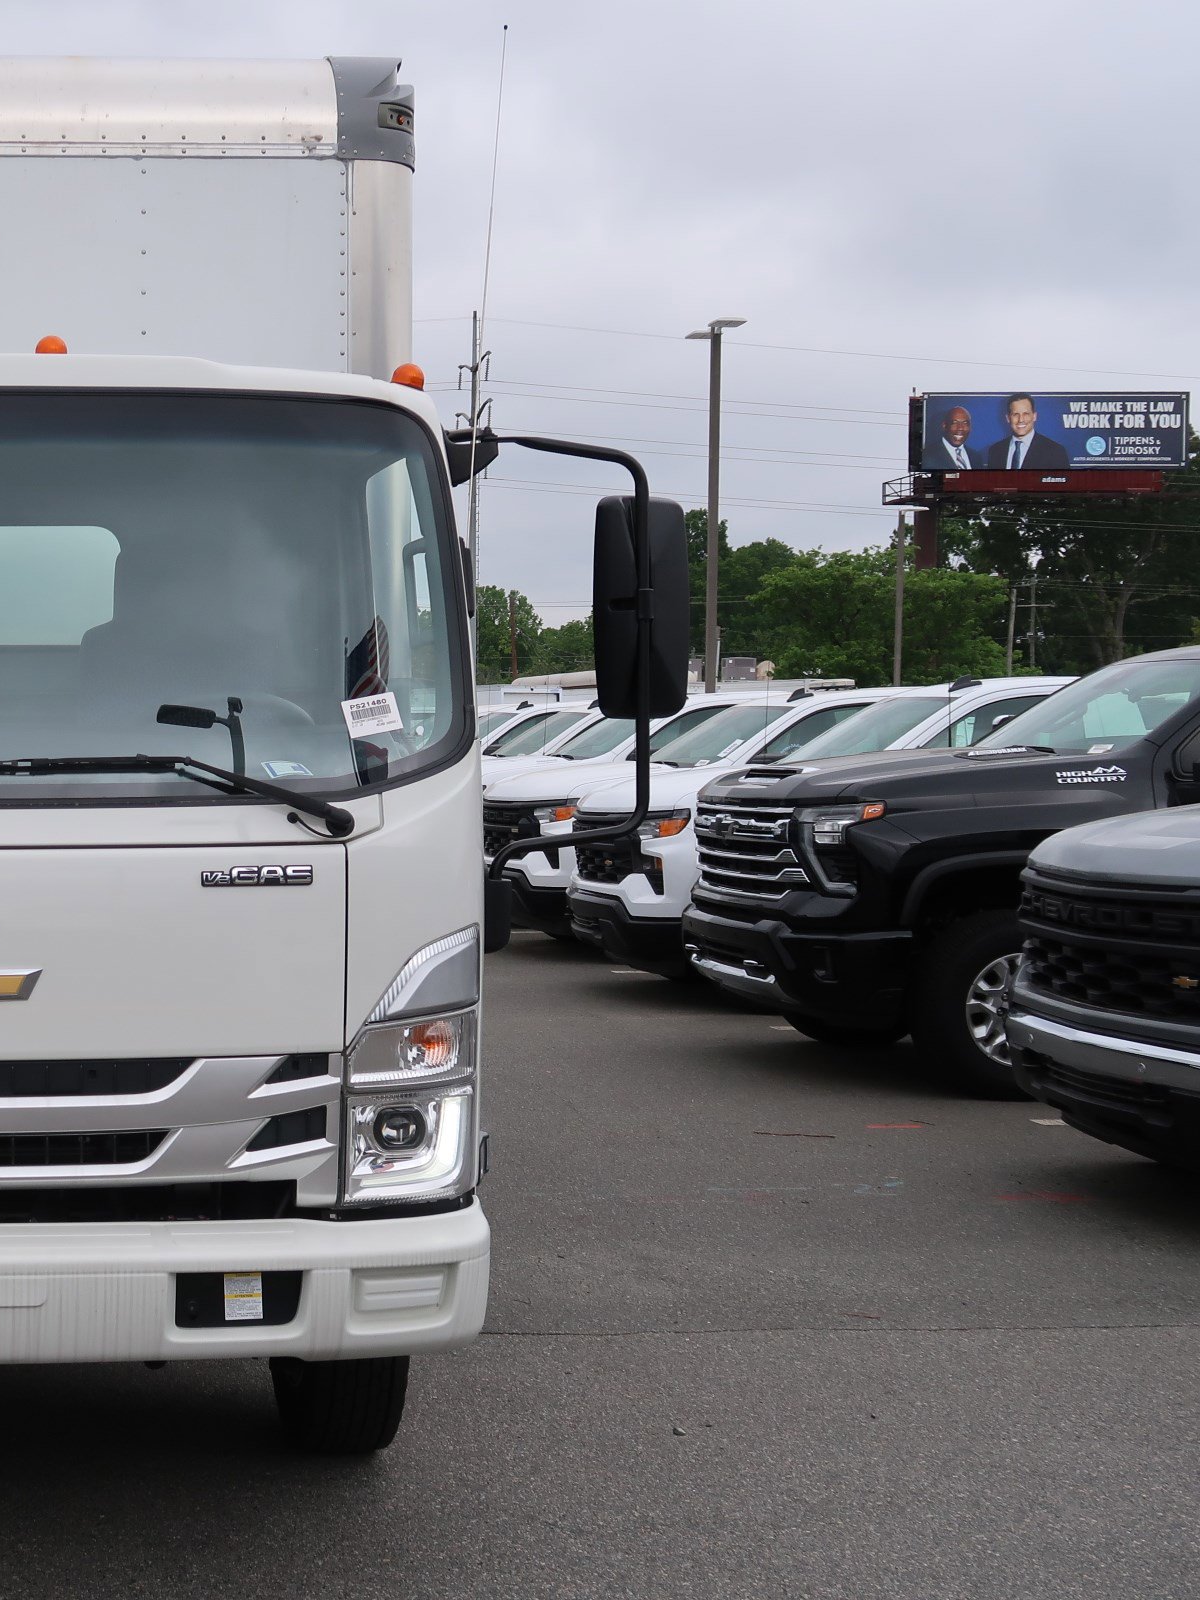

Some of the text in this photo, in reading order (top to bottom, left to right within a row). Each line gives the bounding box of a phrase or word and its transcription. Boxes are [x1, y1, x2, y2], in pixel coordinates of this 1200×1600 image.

[1069, 401, 1175, 413] WE MAKE THE LAW
[1062, 413, 1181, 429] WORK FOR YOU
[1114, 436, 1155, 445] TIPPENS
[1114, 446, 1161, 455] ZUROSKY
[349, 698, 387, 711] PS21480
[1055, 770, 1093, 778] HIGH
[1056, 775, 1127, 784] COUNTRY
[230, 865, 313, 886] GAS
